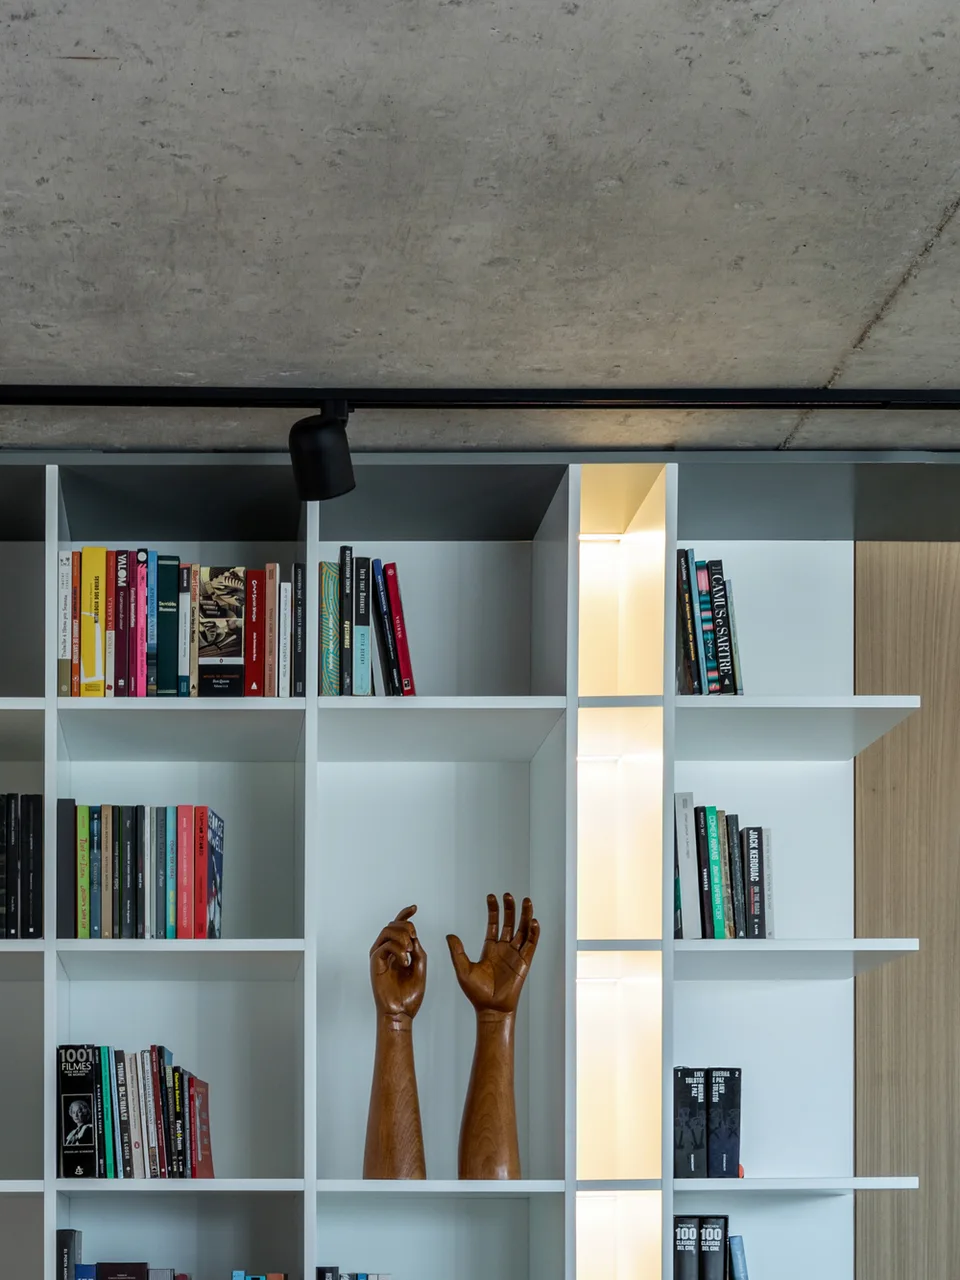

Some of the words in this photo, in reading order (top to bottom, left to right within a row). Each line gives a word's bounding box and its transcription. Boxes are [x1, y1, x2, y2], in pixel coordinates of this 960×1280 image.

[117, 553, 128, 587] YALOM
[711, 574, 727, 618] CAMUS
[716, 618, 724, 626] e
[717, 627, 732, 675] SARTRE
[749, 829, 759, 848] JACK
[749, 849, 760, 882] KEROUAC
[59, 1049, 93, 1062] 1001
[62, 1062, 92, 1071] FILMES
[675, 1227, 697, 1240] 100
[699, 1227, 722, 1240] 100
